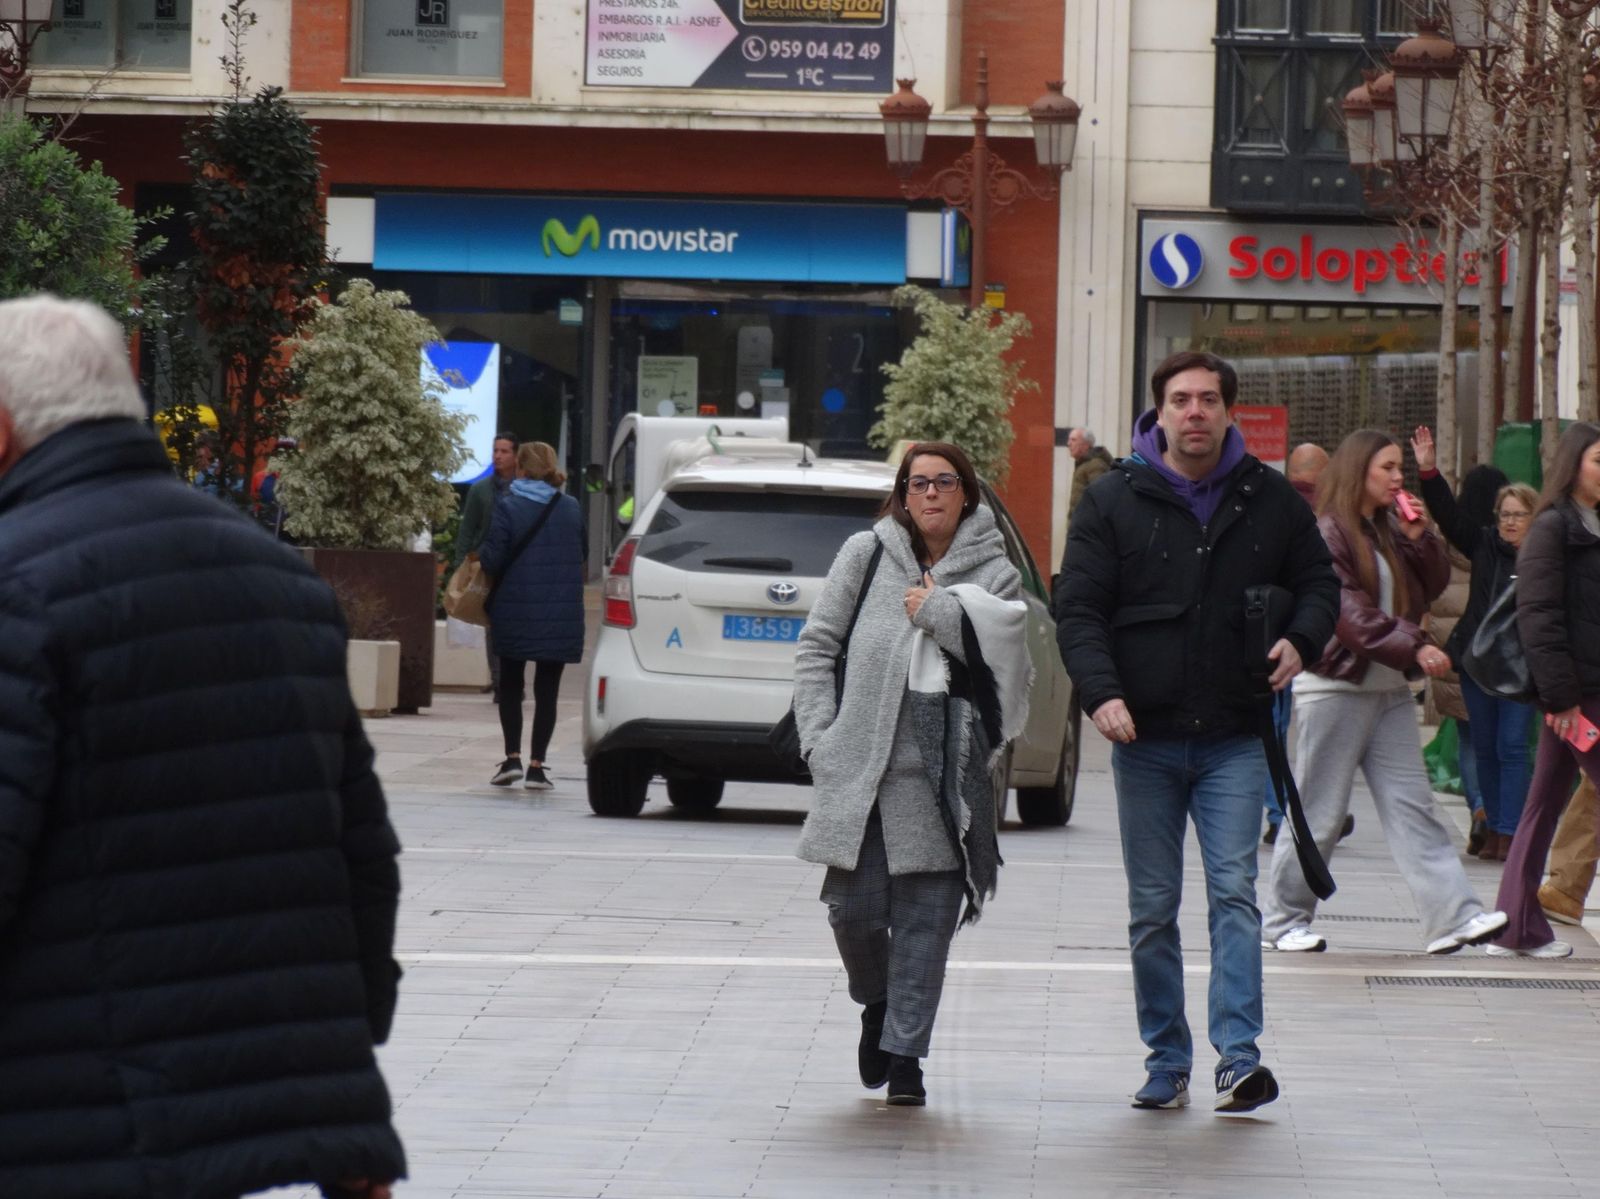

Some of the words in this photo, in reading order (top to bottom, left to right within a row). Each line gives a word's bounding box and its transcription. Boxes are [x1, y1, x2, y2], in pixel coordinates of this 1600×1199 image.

[598, 14, 654, 26] EMBARGOS
[688, 16, 722, 27] ASNEF
[385, 28, 414, 37] JUAN
[598, 31, 666, 43] INMOBILIARIA
[769, 39, 802, 58] 959
[806, 41, 829, 59] 04
[832, 42, 855, 60] 42
[858, 42, 881, 60] 49
[597, 65, 643, 77] SEGUROS
[608, 227, 739, 253] movistar
[665, 626, 682, 649] A
